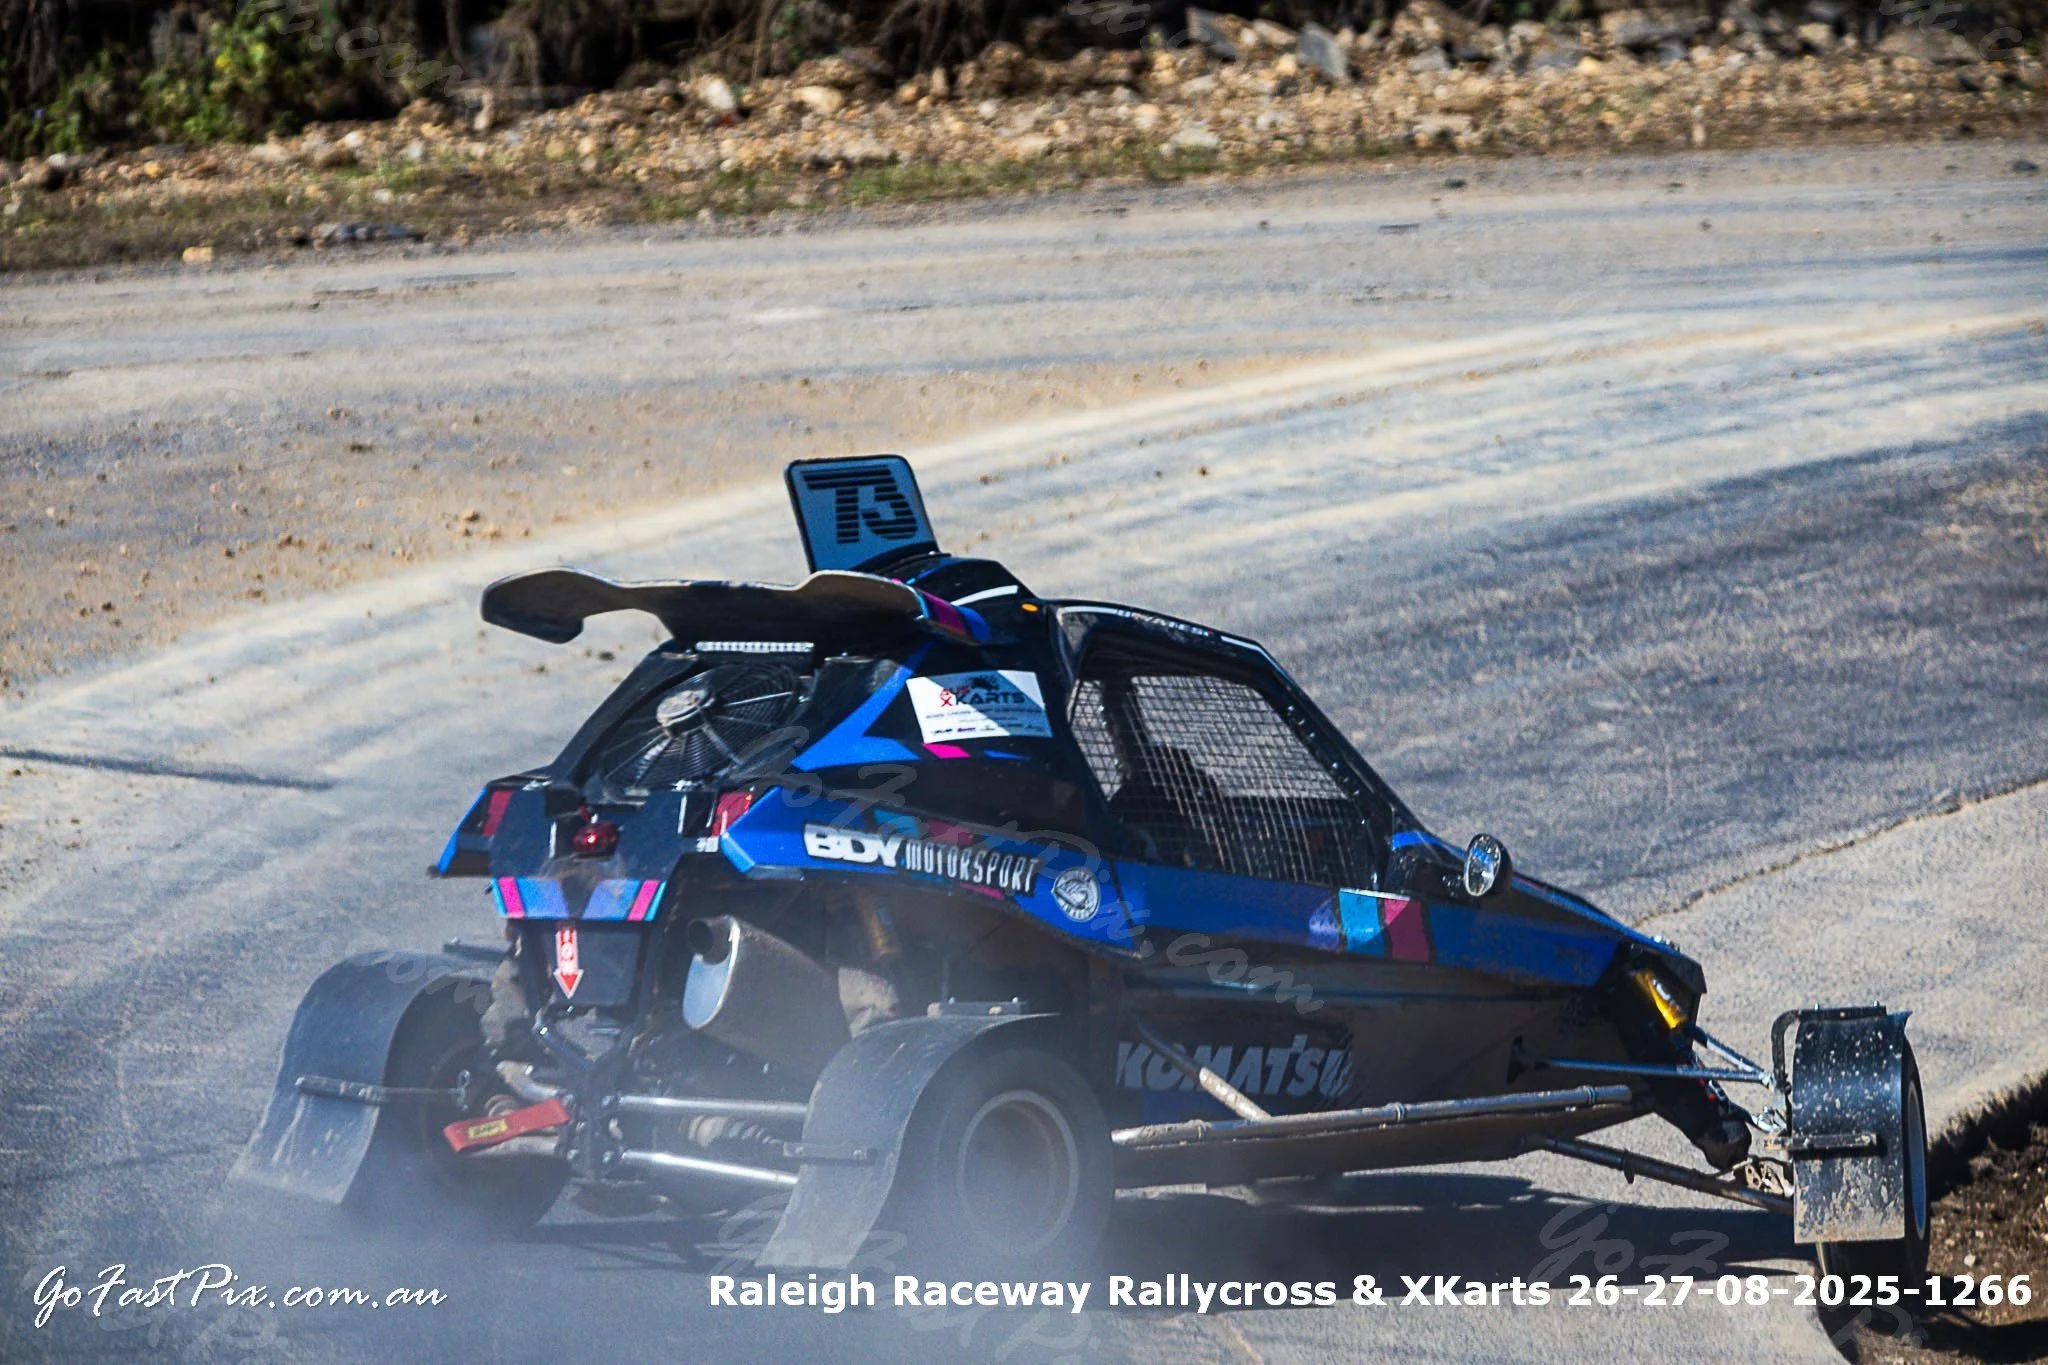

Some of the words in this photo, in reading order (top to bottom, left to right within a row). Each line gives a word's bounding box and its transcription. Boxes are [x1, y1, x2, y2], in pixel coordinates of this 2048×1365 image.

[803, 823, 902, 868] BDY
[905, 838, 1040, 893] MOTORSPORT
[1115, 1034, 1356, 1097] KOMATSU
